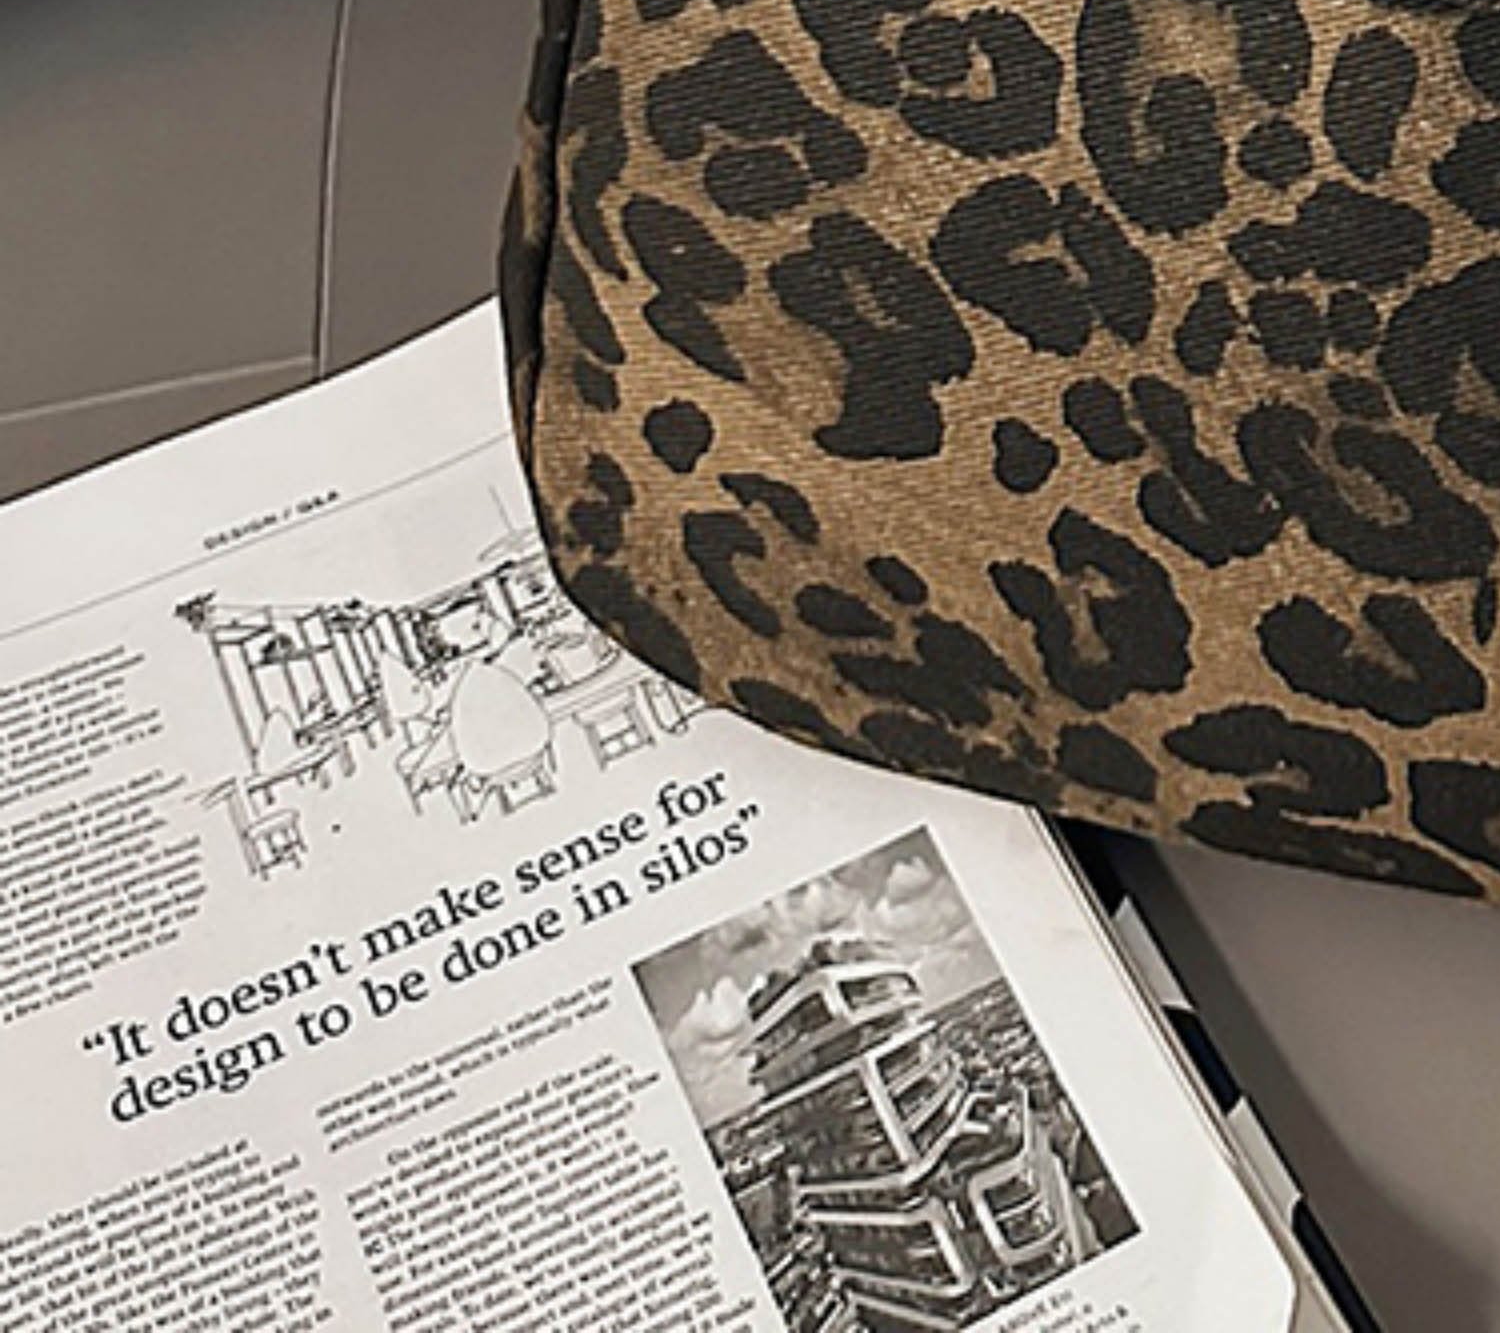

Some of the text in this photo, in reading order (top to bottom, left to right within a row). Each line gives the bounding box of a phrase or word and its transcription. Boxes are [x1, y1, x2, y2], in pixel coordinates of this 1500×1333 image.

[82, 1023, 152, 1066] “It
[166, 943, 349, 1042] doesn’t
[361, 879, 502, 962] make
[514, 813, 647, 894] sense
[656, 772, 725, 826] for
[110, 803, 758, 1122] design to be done in silos”
